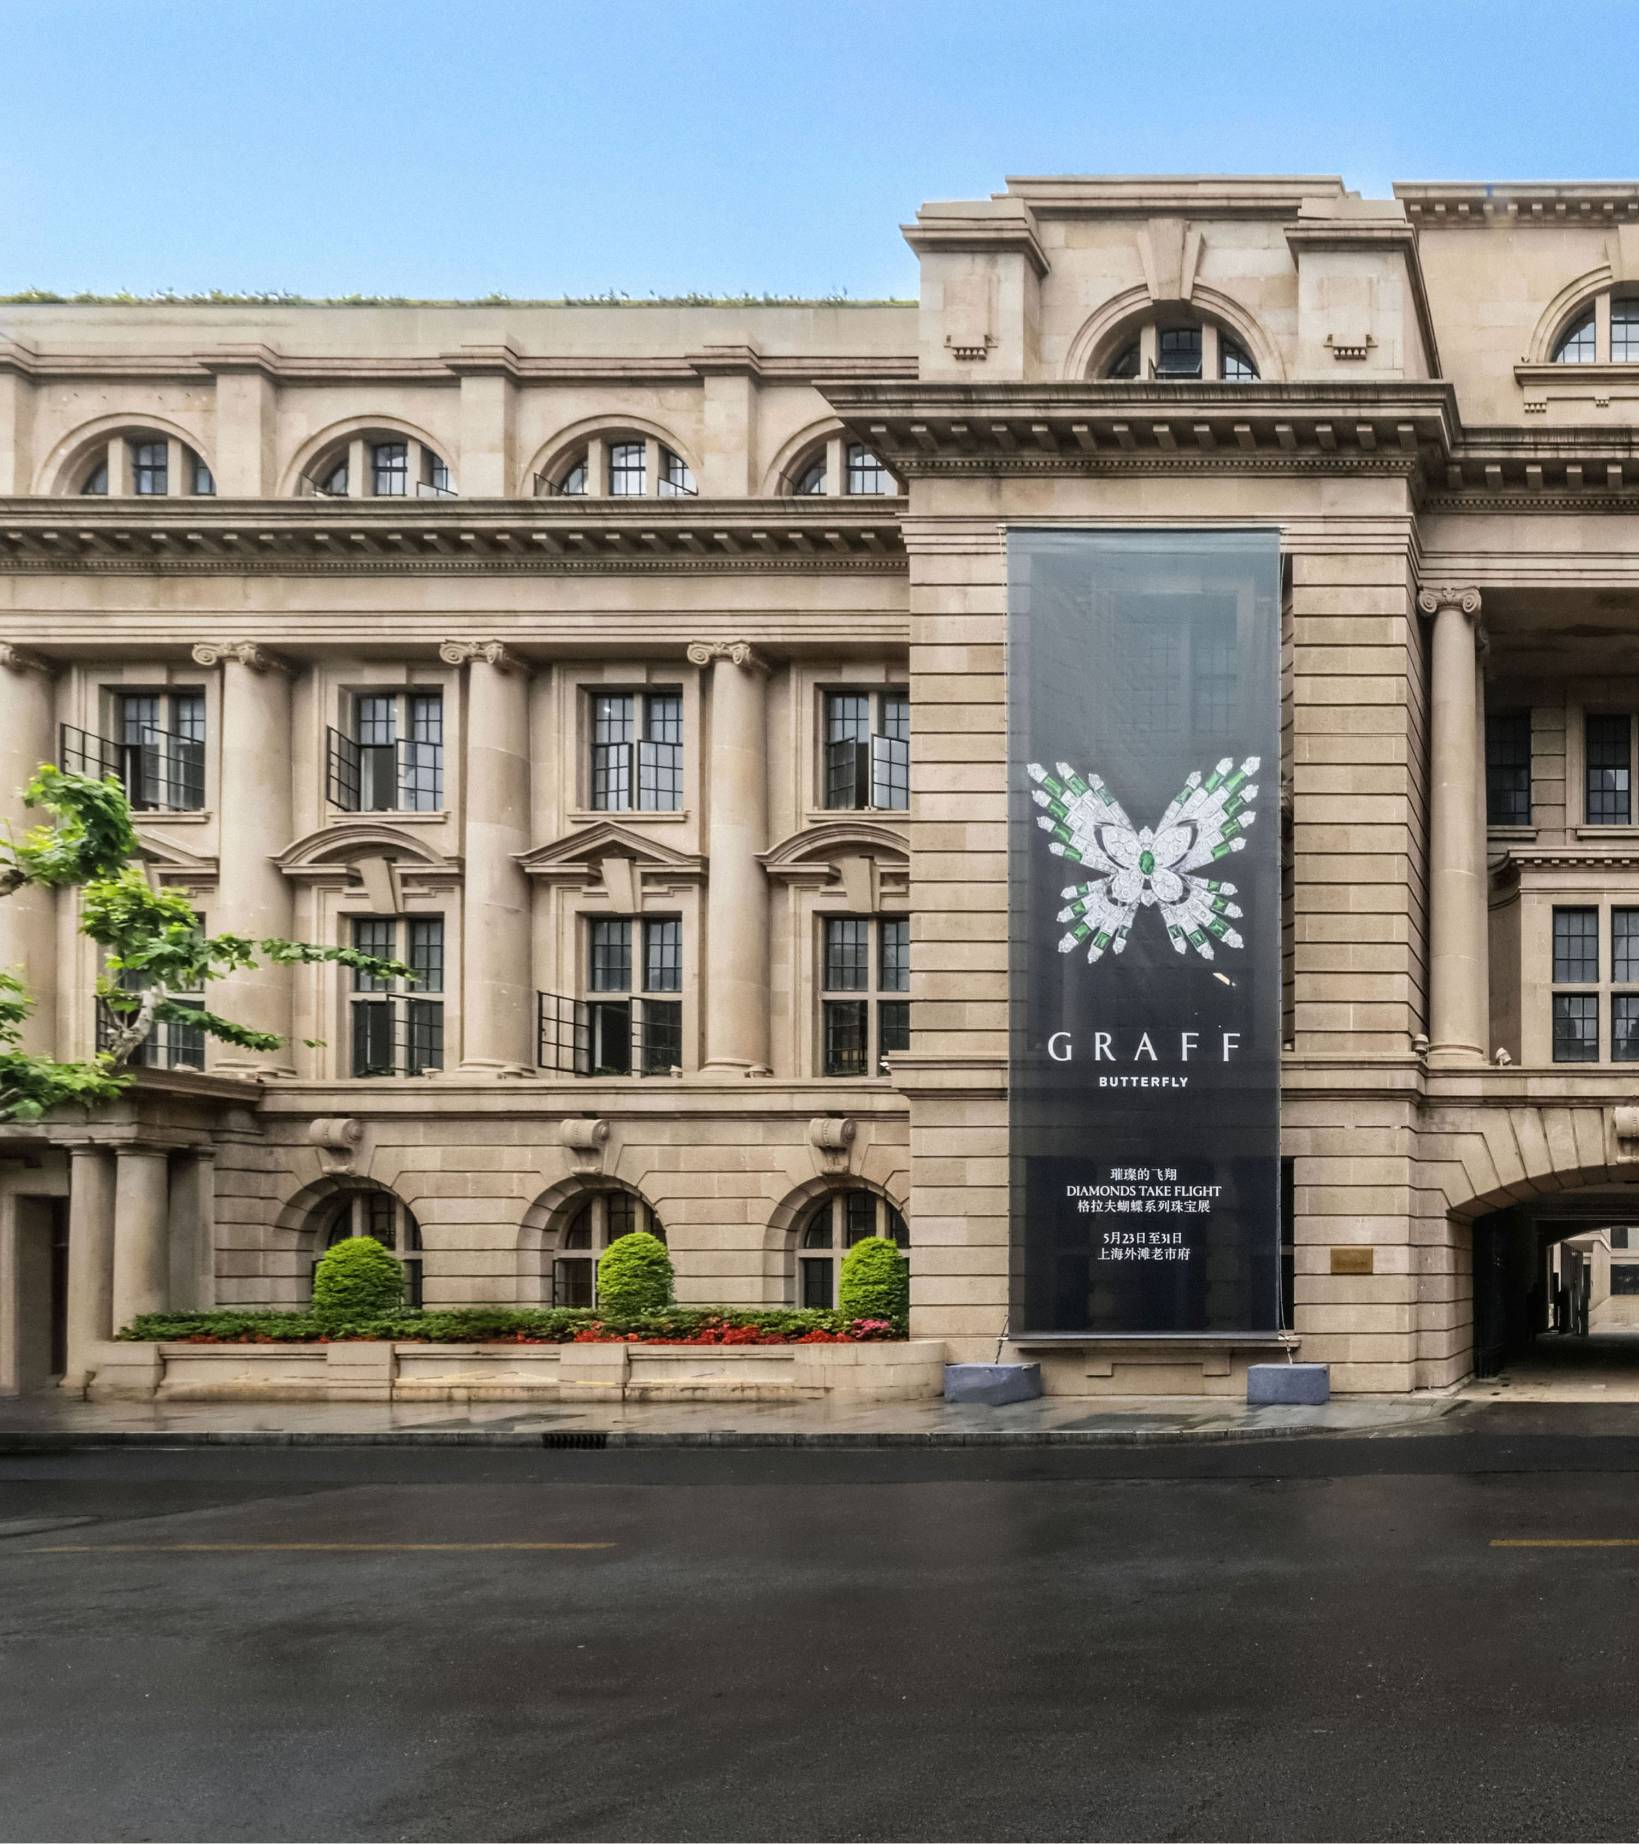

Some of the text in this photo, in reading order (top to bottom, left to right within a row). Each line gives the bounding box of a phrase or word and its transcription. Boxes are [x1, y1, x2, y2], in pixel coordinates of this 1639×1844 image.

[1048, 1032, 1241, 1061] GRAFF
[1099, 1077, 1188, 1087] BUTTERFLY
[1110, 1168, 1177, 1181] 璀璨的飞翔
[1066, 1186, 1222, 1197] DIAMONDS TAKE FLIGHT
[1078, 1200, 1210, 1213] 格拉夫蝴蝶系列珠宝展
[1098, 1248, 1190, 1260] 上海外滩老市府
